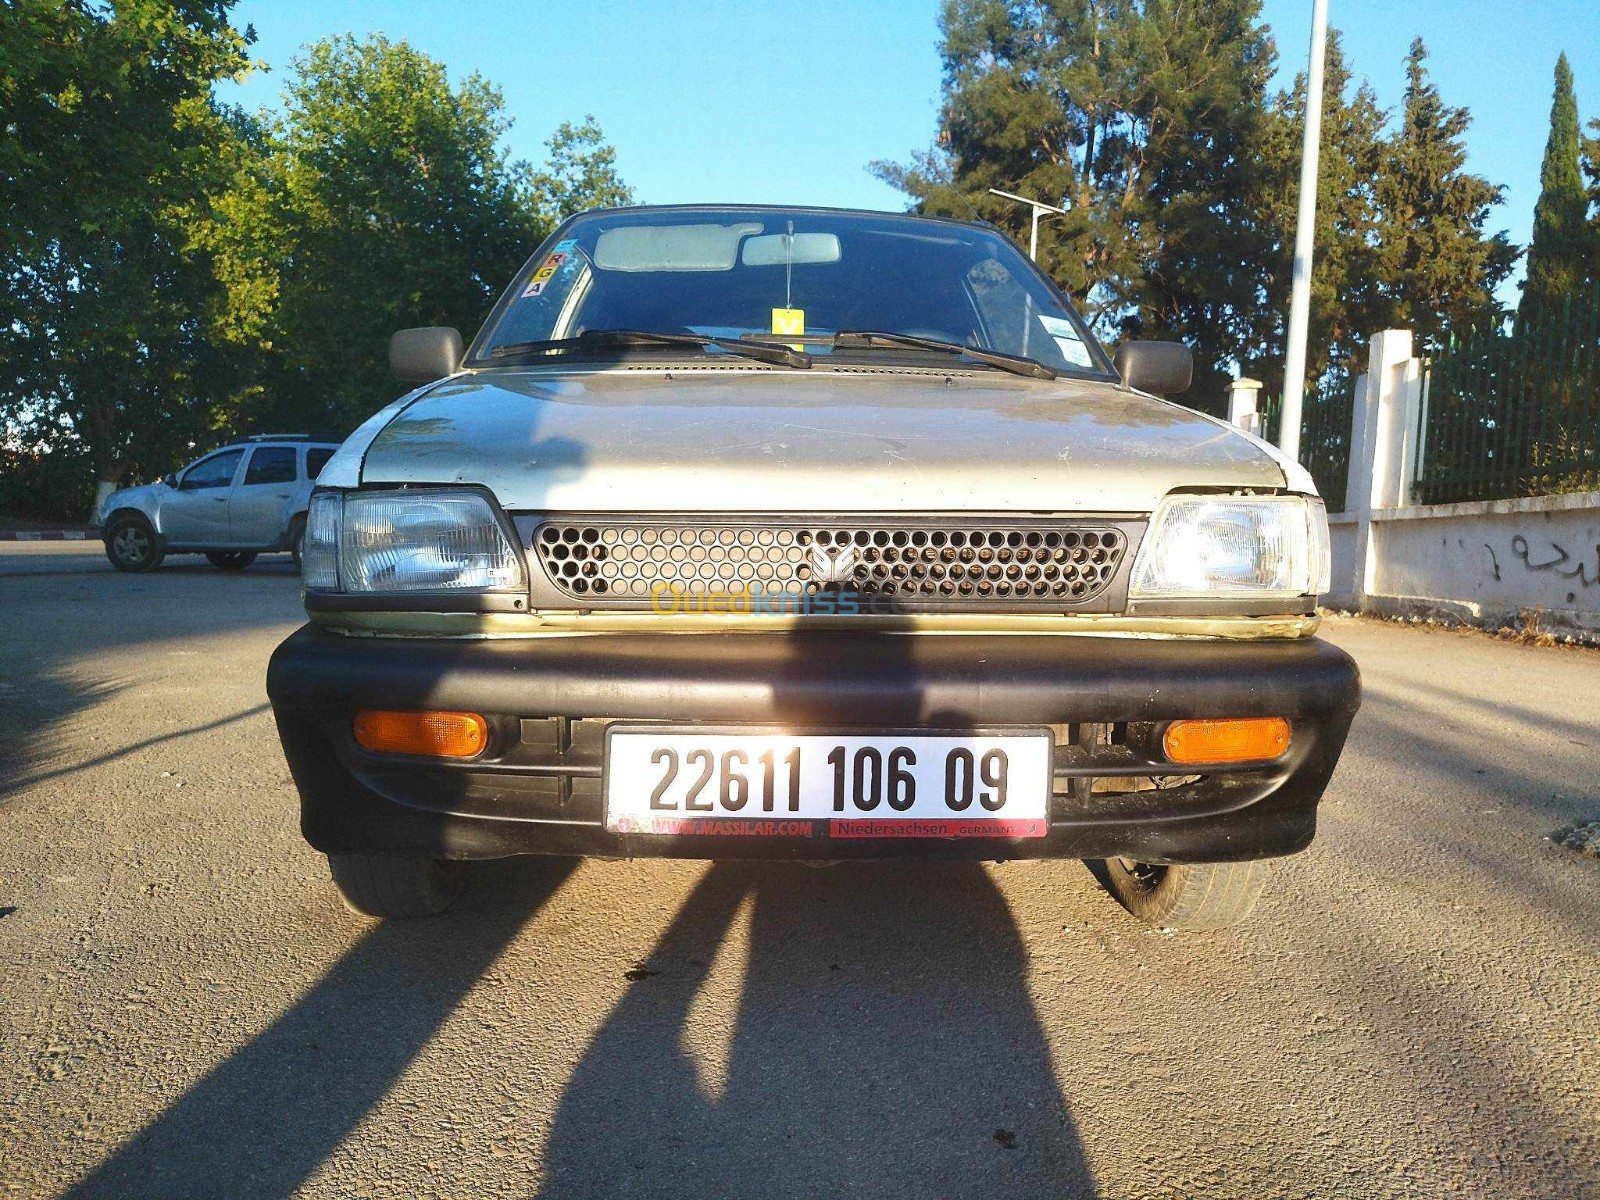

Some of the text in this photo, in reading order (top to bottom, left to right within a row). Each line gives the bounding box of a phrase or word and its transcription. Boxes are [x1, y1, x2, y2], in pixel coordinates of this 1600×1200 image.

[650, 745, 1009, 812] 22611 106 09
[838, 822, 1016, 835] Niedersachsen GERMANY
